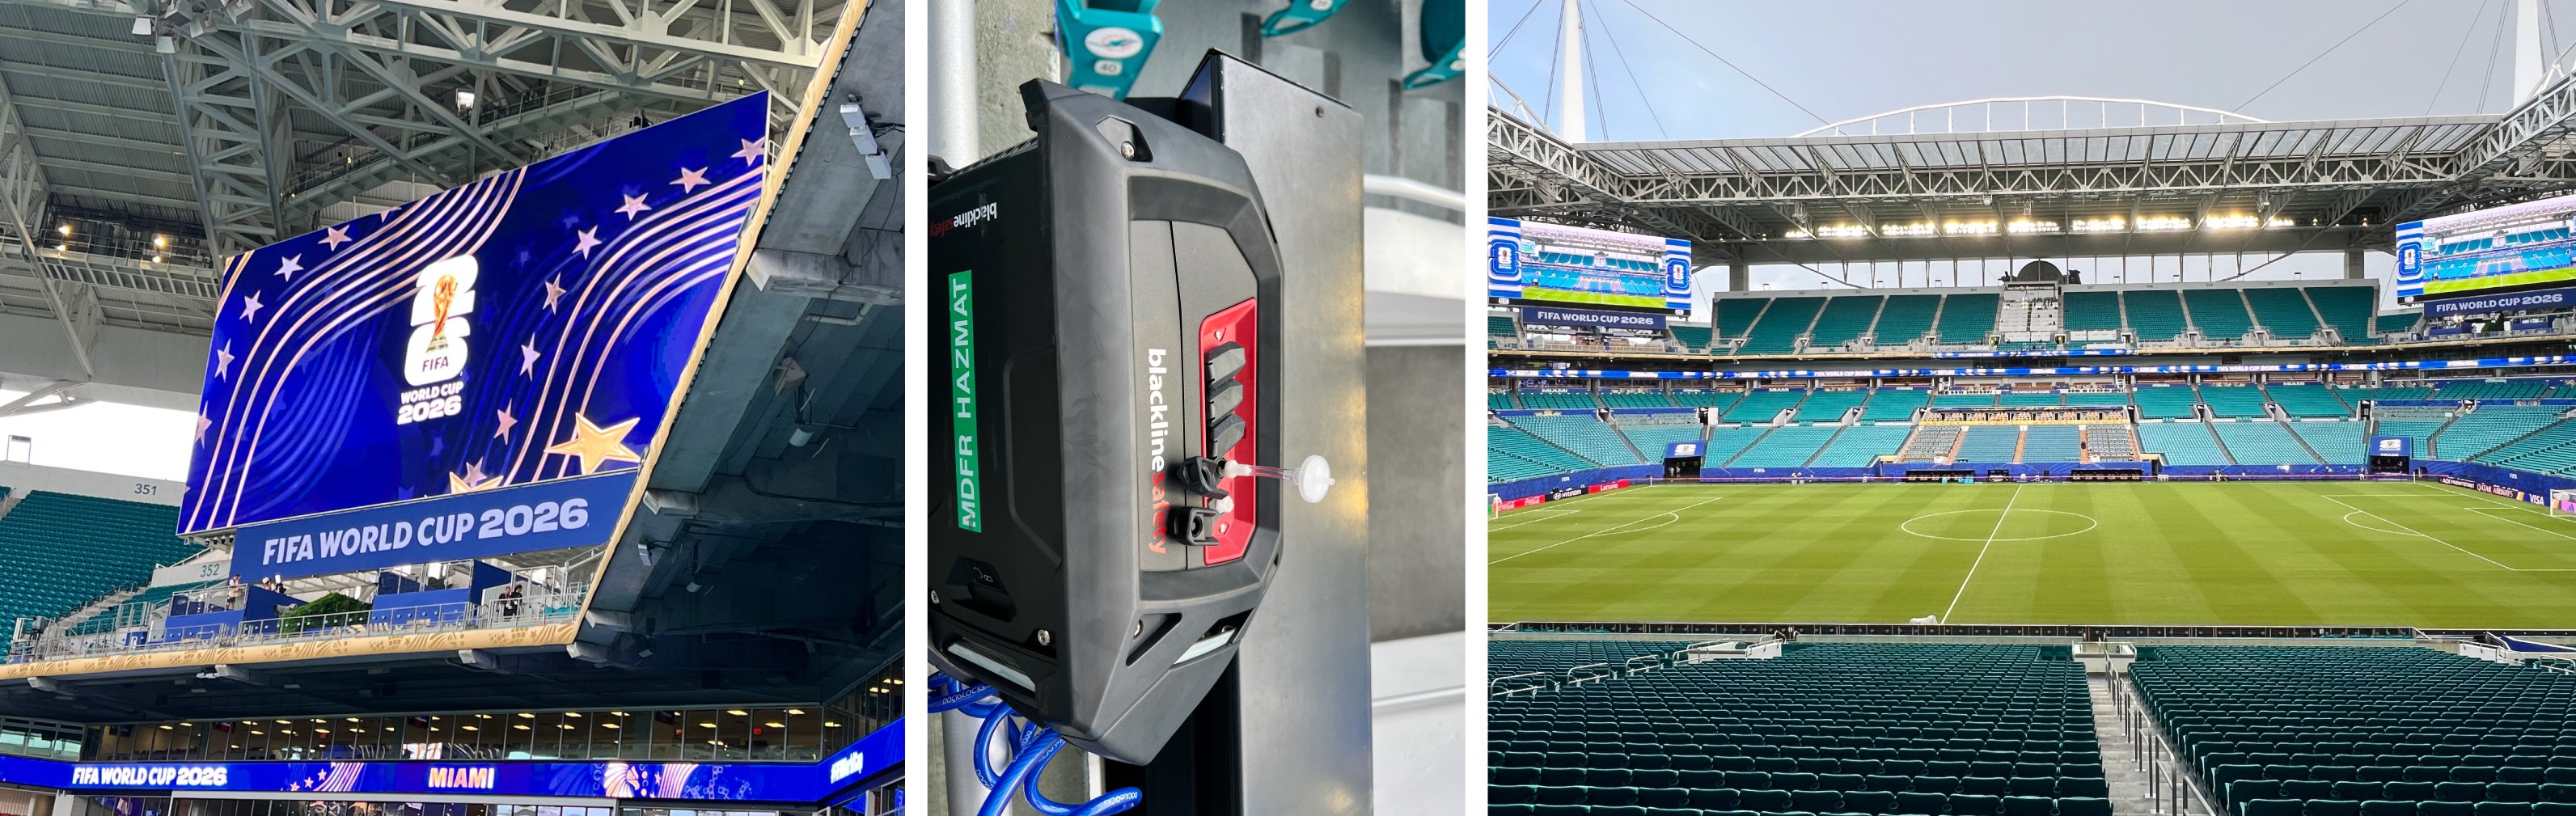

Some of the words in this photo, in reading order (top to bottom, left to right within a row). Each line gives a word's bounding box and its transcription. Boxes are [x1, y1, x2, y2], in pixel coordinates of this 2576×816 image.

[2436, 304, 2458, 312] FIFA
[2460, 301, 2497, 311] WORLD
[2498, 298, 2520, 307] CUP
[2522, 294, 2563, 305] 2026
[1538, 311, 1560, 321] FIFA
[1562, 313, 1598, 323] WORLD
[1600, 315, 1620, 323] CUP
[1621, 316, 1654, 325] 2026
[953, 279, 971, 418] HAZMAT
[422, 356, 449, 372] FIFA
[400, 386, 440, 404] WORLD
[440, 381, 464, 396] CUP
[396, 395, 462, 425] 2026
[134, 483, 157, 496] 351
[958, 435, 975, 527] MDFR
[1600, 484, 1618, 492] Lenovo
[1562, 489, 1582, 498] HYUNDAI
[2529, 493, 2544, 505] VISA
[262, 534, 314, 565] FIFA
[319, 522, 412, 558] WORLD
[417, 512, 475, 547] CUP
[478, 498, 589, 539] 2026
[200, 563, 220, 577] 352
[72, 767, 99, 784] FIFA
[101, 767, 147, 785] WORLD
[148, 767, 176, 785] CUP
[176, 767, 227, 786] 2026
[428, 767, 495, 789] MIAMI
